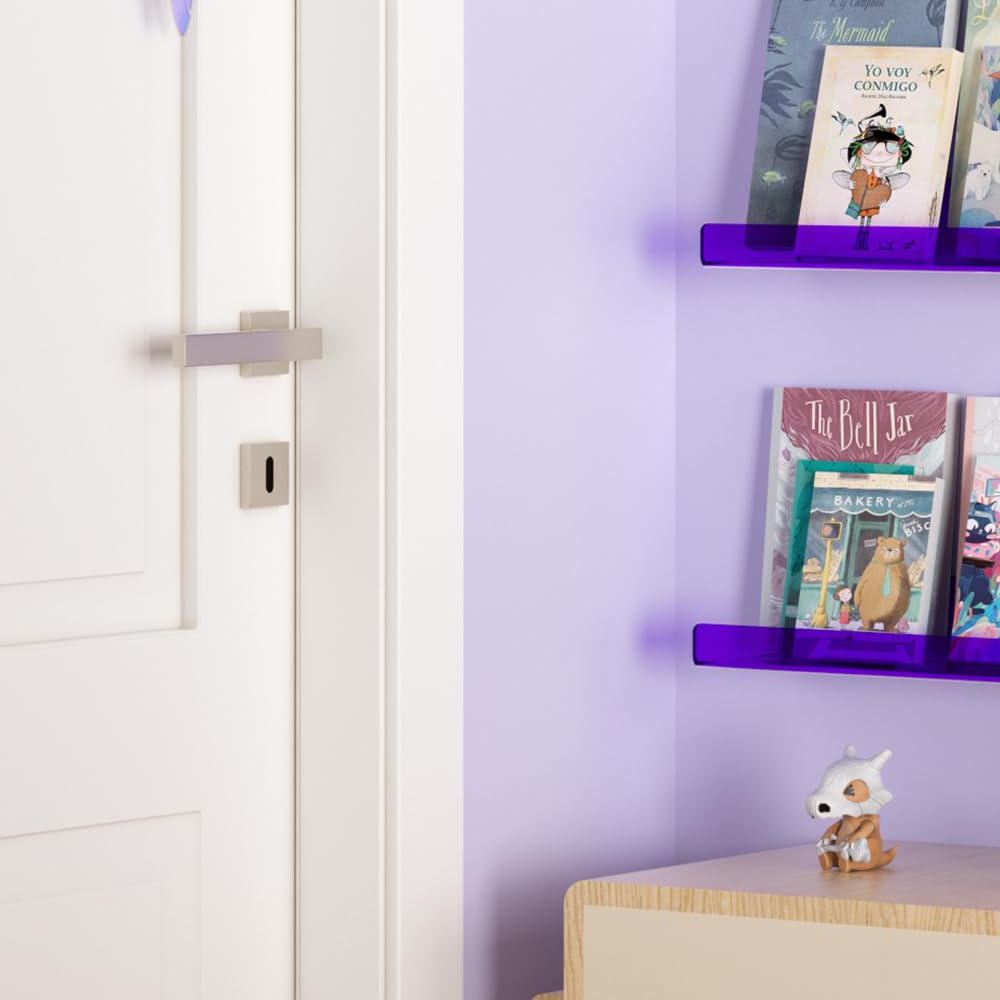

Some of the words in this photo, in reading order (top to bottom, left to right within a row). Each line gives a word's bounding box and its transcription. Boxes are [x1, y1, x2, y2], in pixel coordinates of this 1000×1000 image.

[810, 19, 828, 41] The
[823, 16, 895, 45] Mermaid
[865, 64, 882, 77] YO
[886, 67, 912, 78] VOY
[854, 80, 918, 93] CONMIGO
[805, 399, 833, 440] The
[840, 398, 880, 456] Bell
[885, 401, 915, 442] Jar
[833, 495, 895, 508] BAKERY
